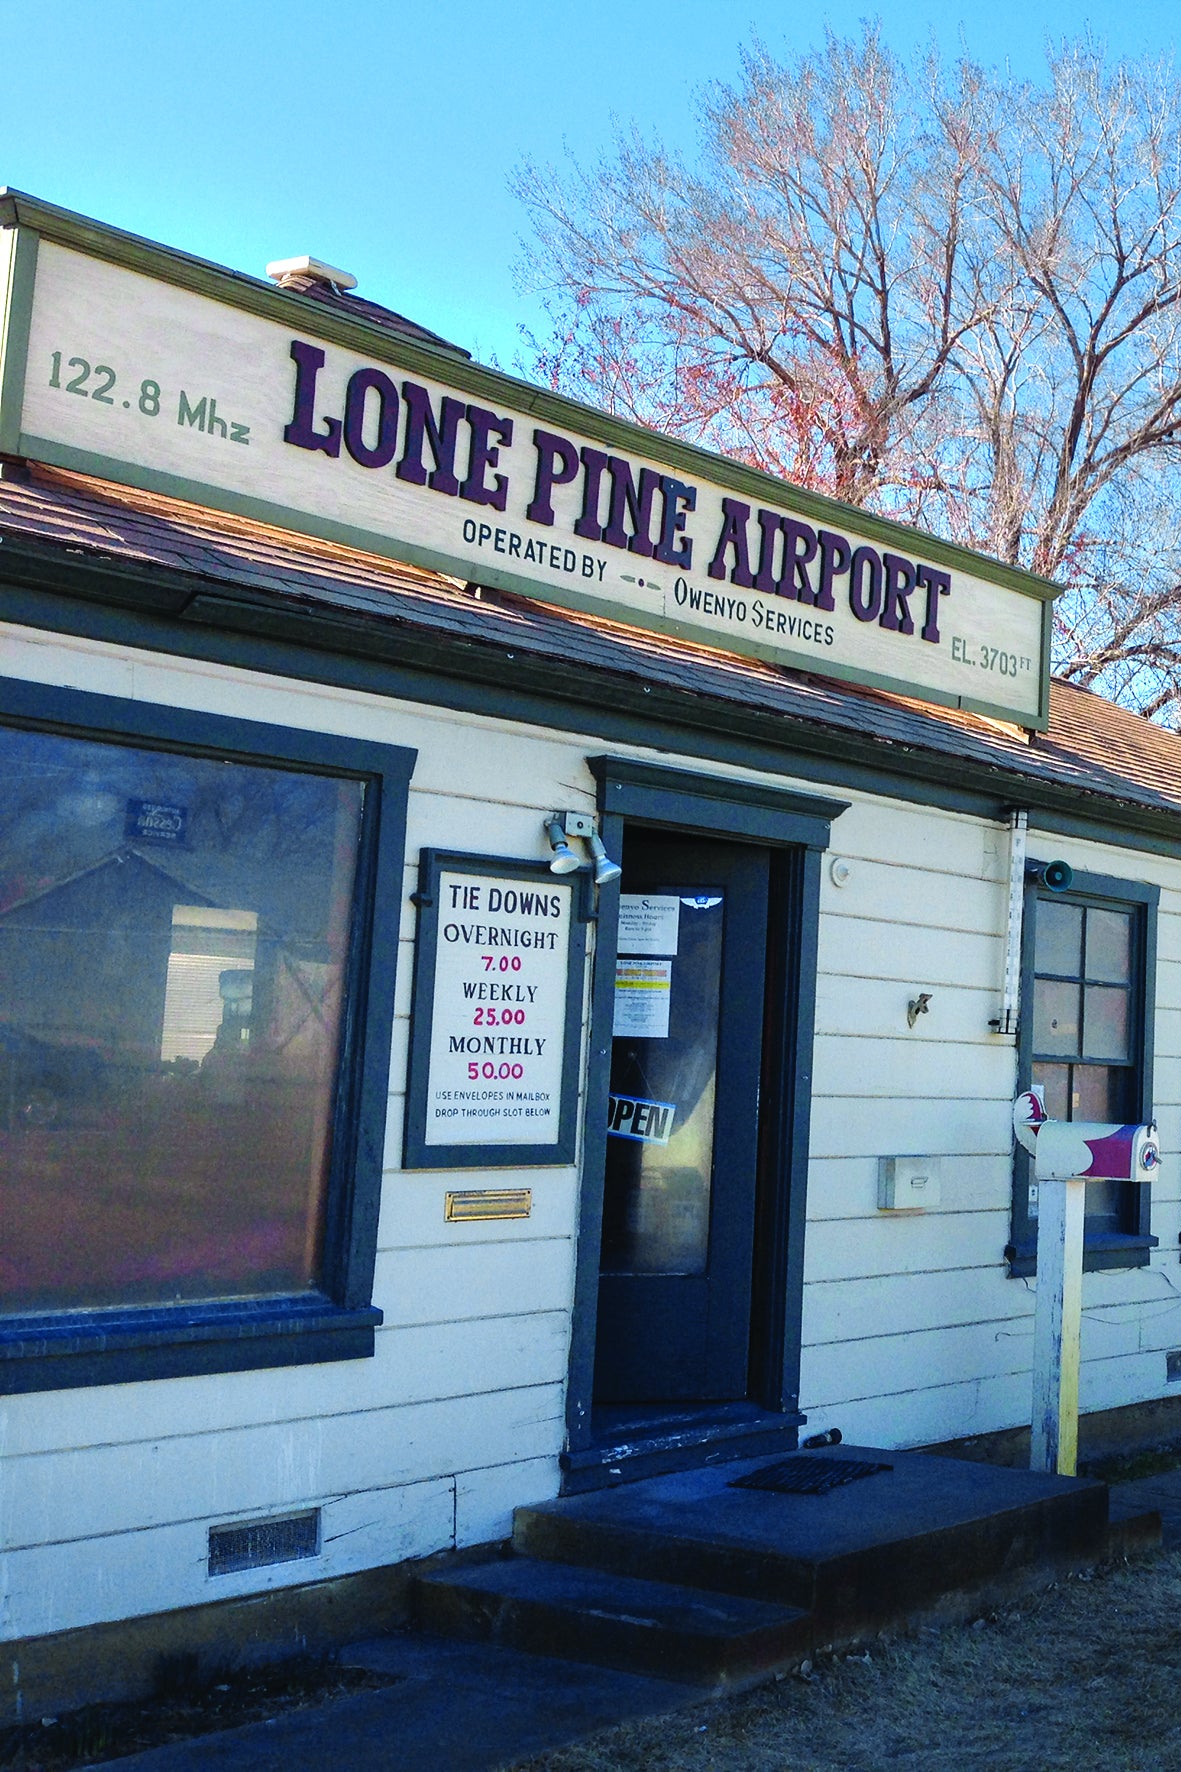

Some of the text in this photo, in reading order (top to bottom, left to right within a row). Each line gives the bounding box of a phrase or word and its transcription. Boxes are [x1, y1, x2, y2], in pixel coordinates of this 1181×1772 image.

[48, 351, 250, 445] 122.8 Mhz
[284, 340, 952, 644] LONE PINE AIRPORT
[462, 518, 607, 582] OPERATED BY
[751, 599, 835, 646] SERVICES
[951, 636, 976, 667] EL.
[449, 884, 561, 918] TIE DOWNS
[443, 923, 559, 950] OVERNIGHT
[481, 955, 522, 972] 7.00
[462, 982, 538, 1003] WEEKLY
[473, 1007, 525, 1026] 25.00
[448, 1035, 546, 1056] MONTHLY
[467, 1061, 524, 1080] 50.00
[435, 1090, 551, 1101] USE ENVELOPES IN MAILBOX
[435, 1107, 551, 1118] DROP THROUGH SLOT BELOW
